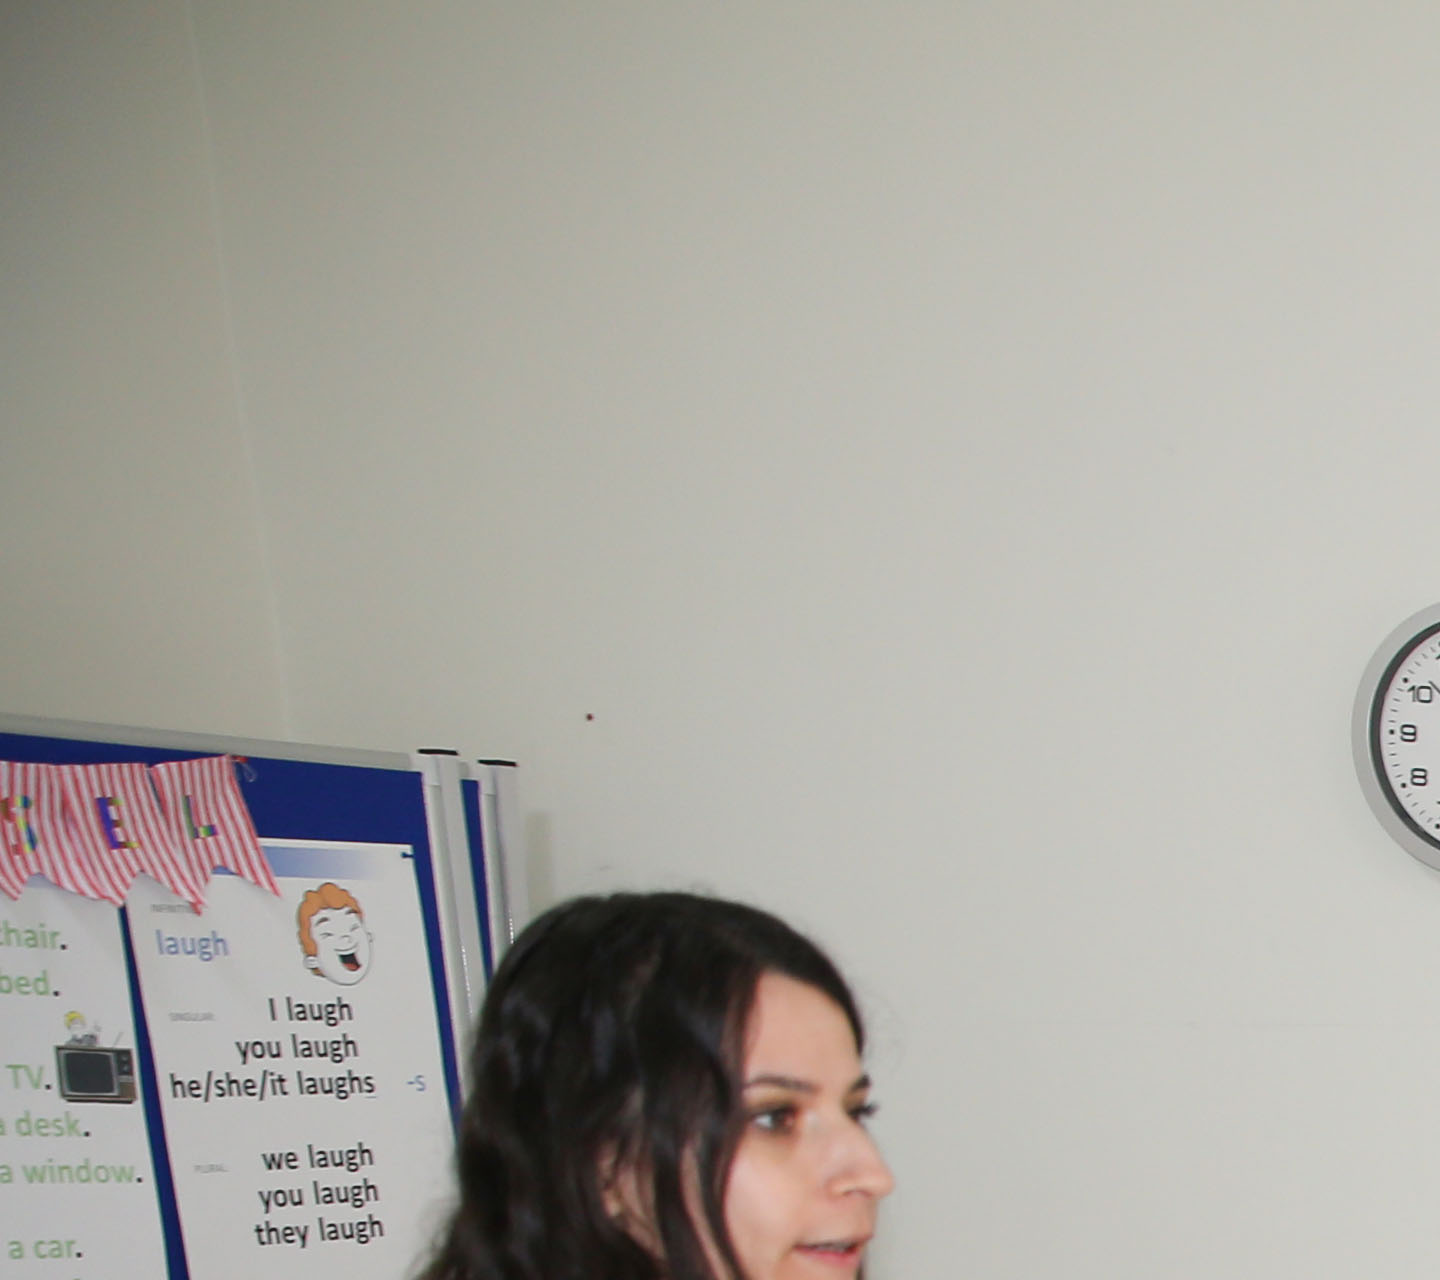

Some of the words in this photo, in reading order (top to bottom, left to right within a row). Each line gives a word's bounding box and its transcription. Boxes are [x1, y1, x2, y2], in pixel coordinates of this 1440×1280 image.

[1407, 685, 1433, 703] 10
[1400, 724, 1417, 743] 9
[1410, 767, 1427, 787] 8
[0, 920, 67, 950] hair.
[155, 929, 229, 962] laugh
[268, 998, 277, 1021] I
[286, 996, 353, 1027] laugh
[235, 1041, 282, 1065] you
[291, 1033, 359, 1063] laugh
[5, 1063, 52, 1091] TV.
[169, 1070, 288, 1102] he/she/it
[297, 1069, 377, 1100] laughs
[15, 1110, 90, 1137] desk.
[22, 1158, 143, 1184] window.
[262, 1150, 298, 1170] we
[307, 1142, 374, 1172] laugh
[258, 1188, 304, 1214] you
[313, 1178, 379, 1209] laugh
[255, 1220, 309, 1249] they
[318, 1214, 384, 1245] laugh
[8, 1240, 24, 1259] a
[34, 1238, 83, 1259] car.
